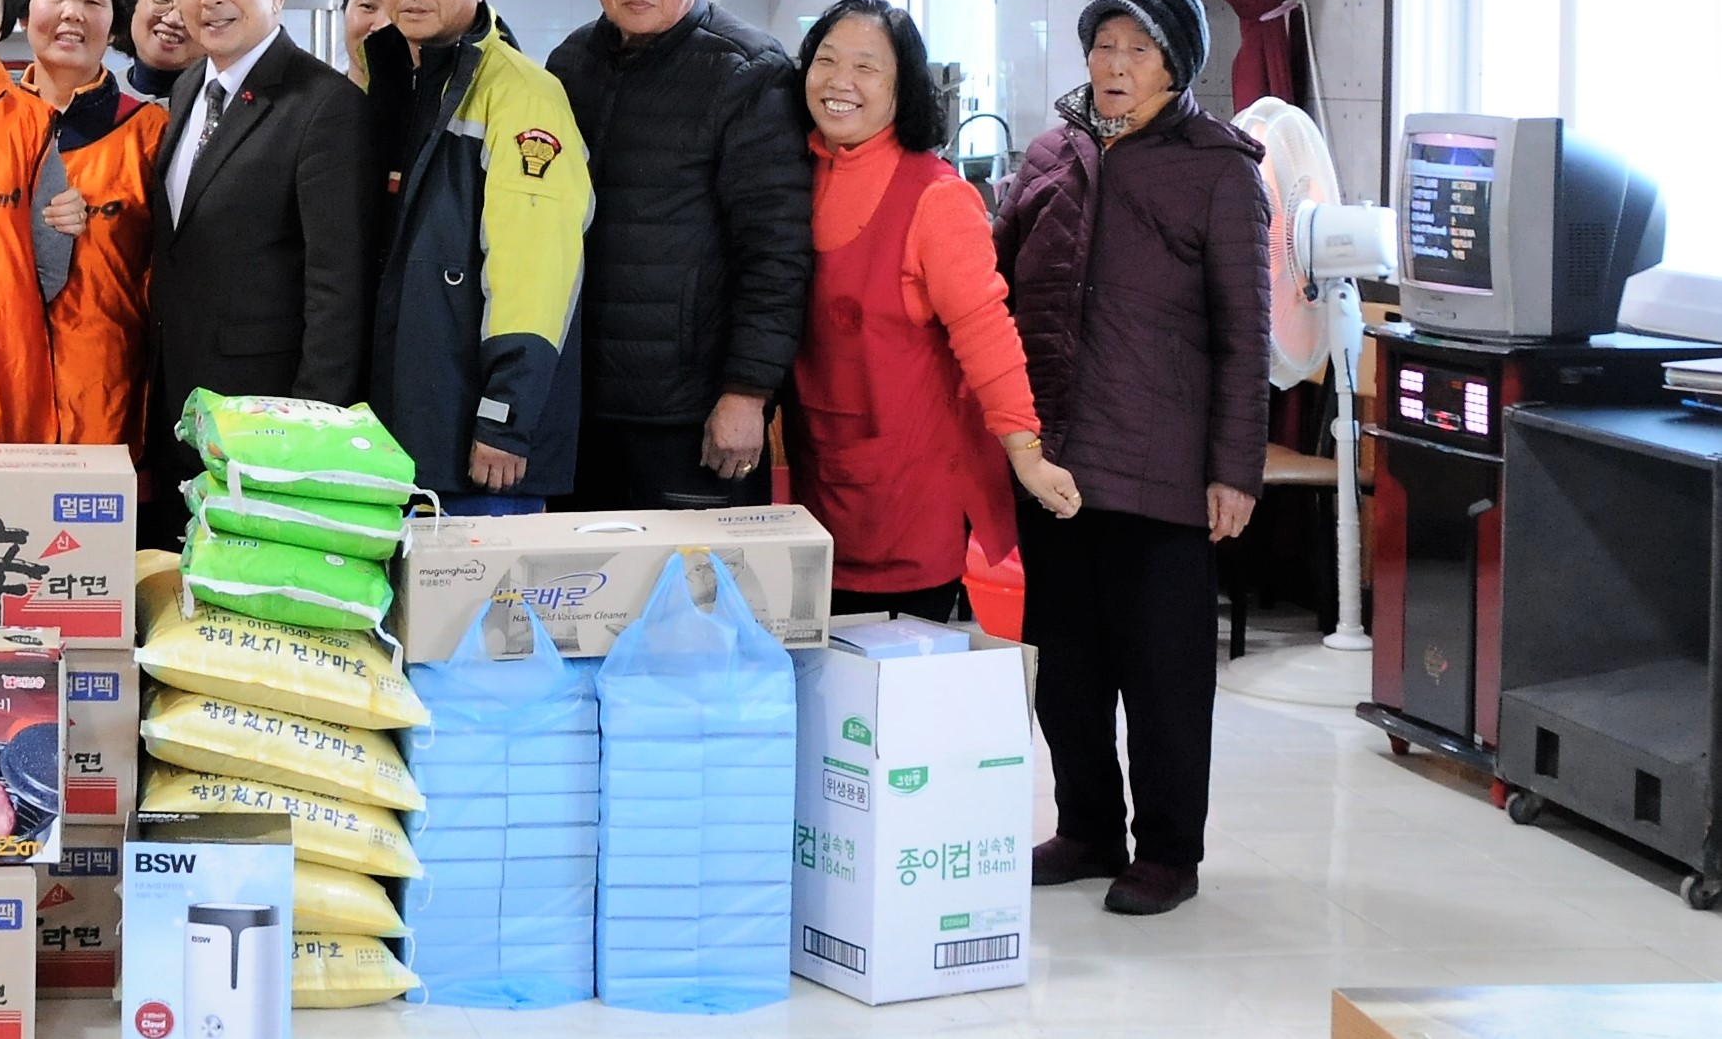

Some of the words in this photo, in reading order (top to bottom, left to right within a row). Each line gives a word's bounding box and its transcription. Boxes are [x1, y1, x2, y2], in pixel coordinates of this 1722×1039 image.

[59, 496, 118, 520] 멀티팩
[48, 572, 110, 600] 라면
[558, 612, 592, 621] Vacuum
[594, 611, 628, 620] Cleaner
[826, 777, 867, 805] 위생용품
[821, 832, 855, 861] 실속형
[977, 834, 1016, 857] 실속형
[135, 852, 197, 874] BSW
[821, 855, 856, 882] 184ml
[896, 840, 971, 887] 종이컵
[977, 858, 1016, 876] 184ml
[42, 925, 102, 951] 라면
[191, 935, 212, 944] BSW
